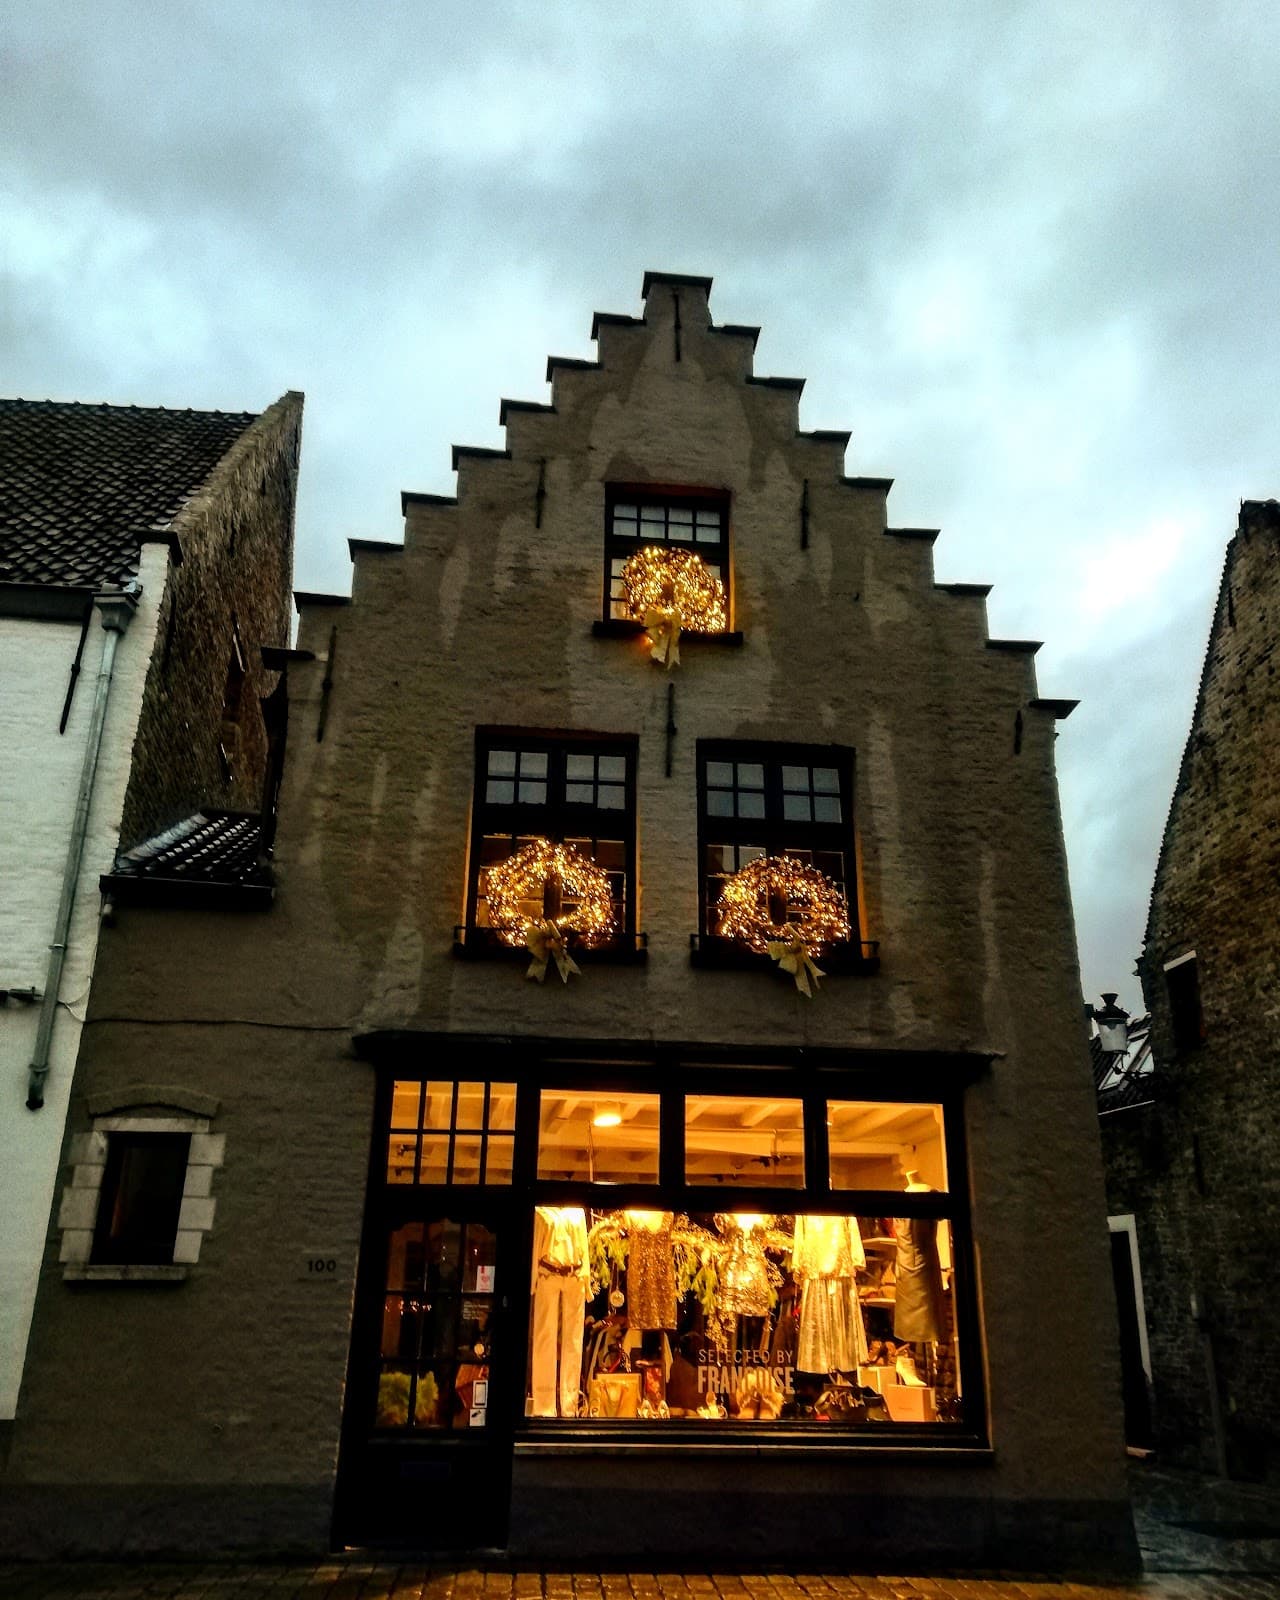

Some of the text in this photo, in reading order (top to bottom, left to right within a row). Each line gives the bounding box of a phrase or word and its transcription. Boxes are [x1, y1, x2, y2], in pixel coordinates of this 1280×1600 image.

[308, 1259, 337, 1273] 100
[698, 1348, 794, 1364] SELECTED BY
